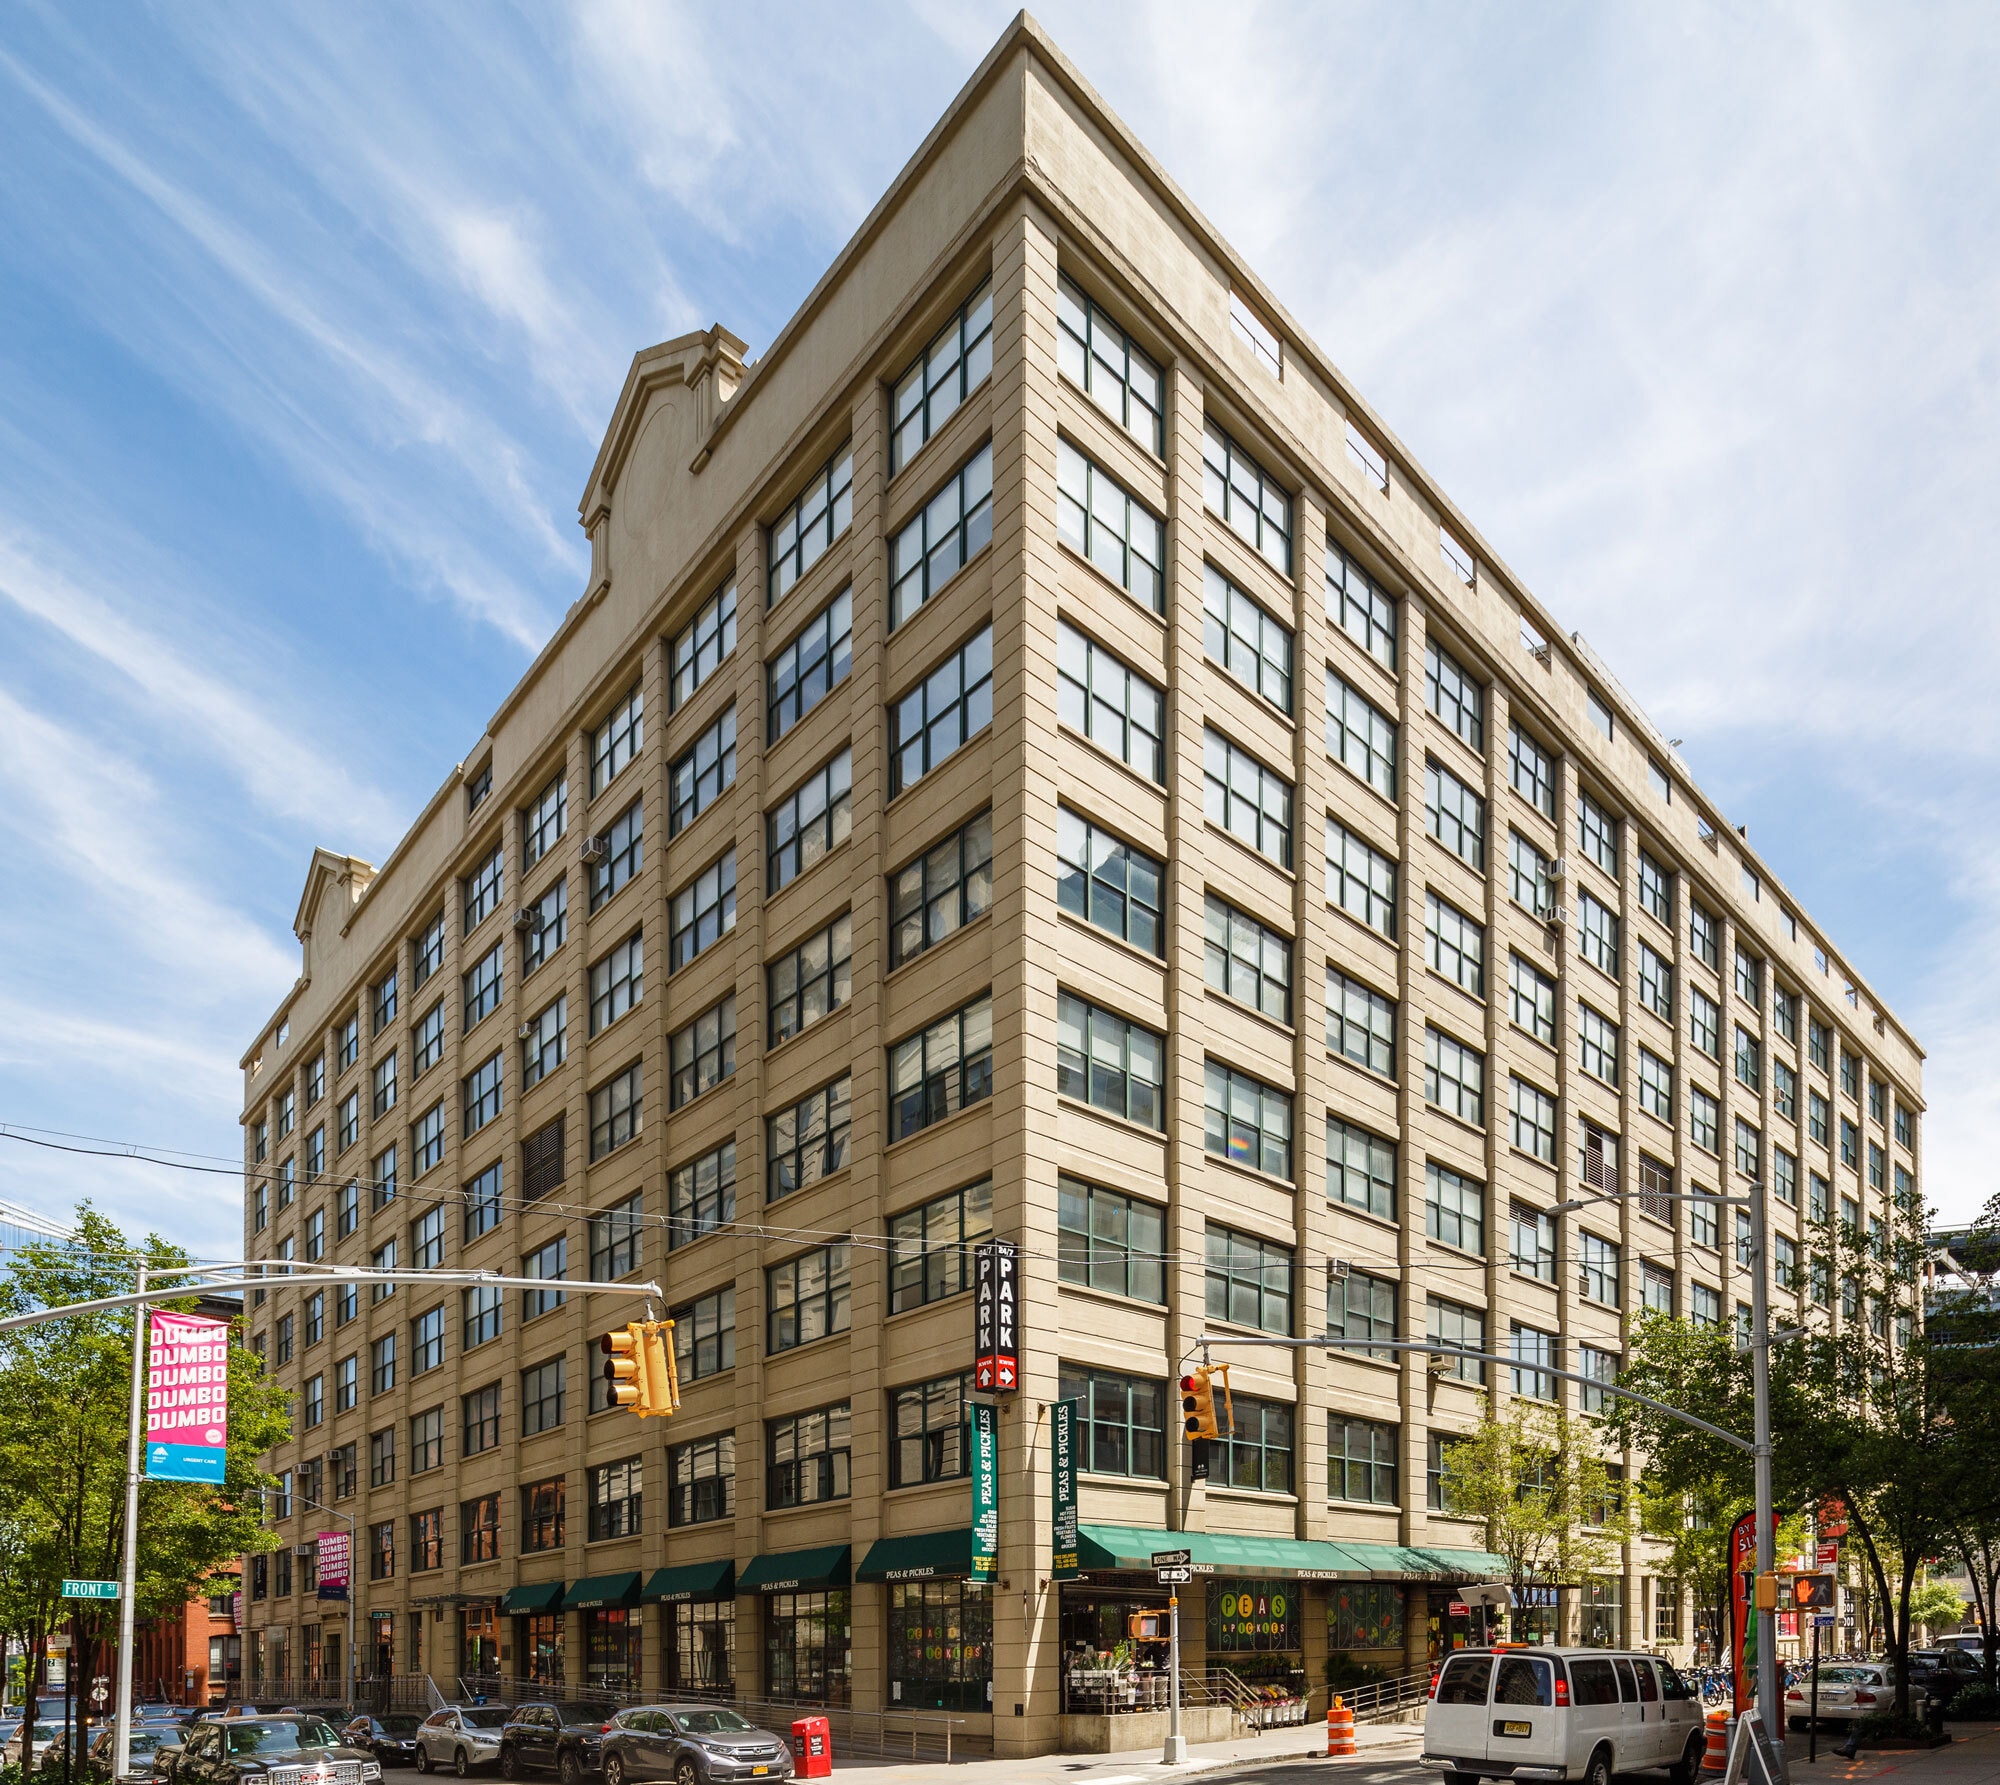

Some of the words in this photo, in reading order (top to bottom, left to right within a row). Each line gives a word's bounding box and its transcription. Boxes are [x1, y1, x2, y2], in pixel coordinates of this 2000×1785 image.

[998, 1246, 1014, 1256] 24/7
[980, 1259, 992, 1349] PARK
[1000, 1258, 1014, 1348] PARK
[151, 1326, 227, 1346] DUMBO
[150, 1345, 227, 1367] DUMBO
[149, 1365, 226, 1388] DUMBO
[148, 1386, 226, 1410] DUMBO
[148, 1406, 226, 1431] DUMBO
[980, 1409, 991, 1458] PICKLES
[1058, 1405, 1069, 1455] PICKLES
[981, 1460, 992, 1472] &
[1059, 1457, 1069, 1468] &
[981, 1474, 992, 1505] PEAS
[1059, 1470, 1069, 1502] PEAS
[1739, 1524, 1750, 1535] BY
[319, 1535, 348, 1546] DUMBO
[320, 1543, 348, 1555] DUMBO
[320, 1552, 348, 1563] DUMBO
[1173, 1553, 1185, 1561] WAY
[320, 1561, 348, 1572] DUMBO
[886, 1570, 901, 1579] PEAS
[909, 1566, 934, 1577] PICKLES
[320, 1569, 348, 1581] DUMBO
[65, 1582, 102, 1595] FRONT
[761, 1582, 773, 1591] PEAS
[779, 1580, 799, 1588] PICKLES
[1222, 1596, 1285, 1615] PEAS
[907, 1626, 943, 1639] PEAS
[1230, 1623, 1285, 1633] PICKLES
[916, 1646, 982, 1659] PICKLES
